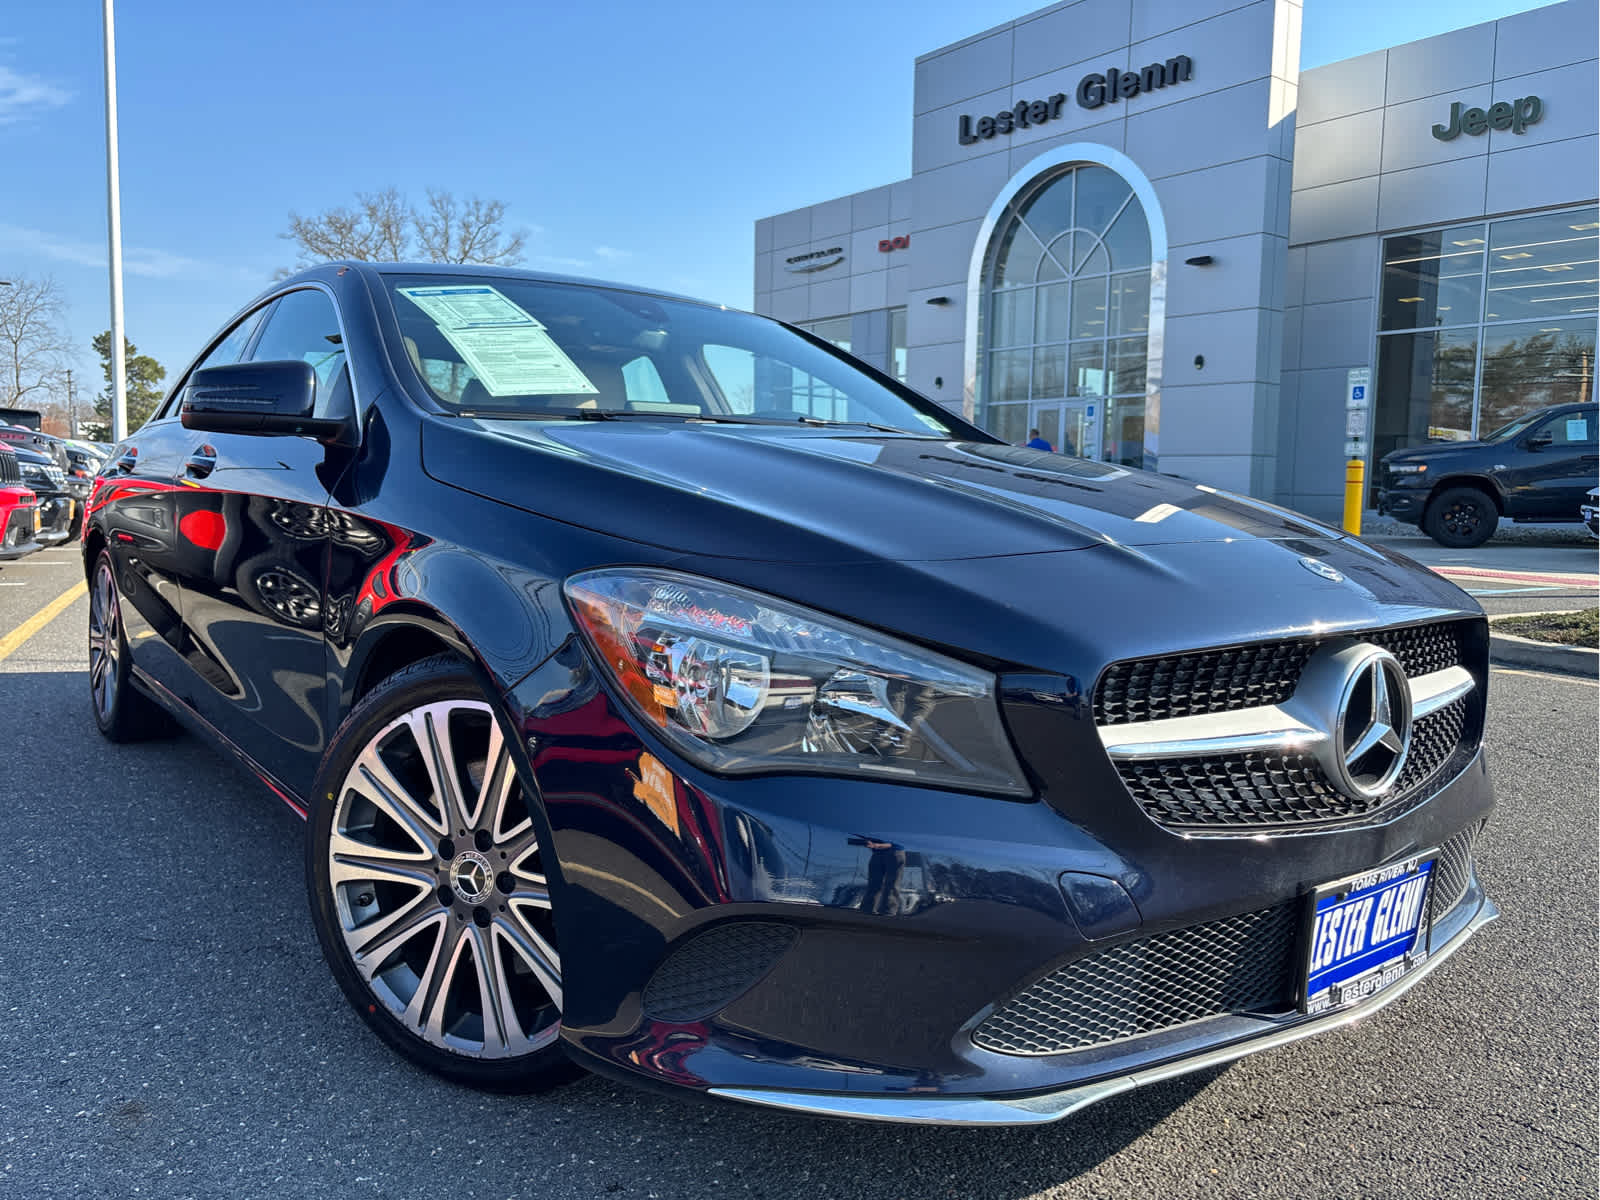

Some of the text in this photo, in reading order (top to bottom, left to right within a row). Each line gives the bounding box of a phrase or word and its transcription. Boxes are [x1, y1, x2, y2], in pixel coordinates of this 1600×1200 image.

[959, 54, 1194, 146] Lester Glenn
[1432, 95, 1544, 141] Jeep
[1351, 872, 1378, 892] TOMS
[1308, 875, 1428, 975] LESTER GLENN
